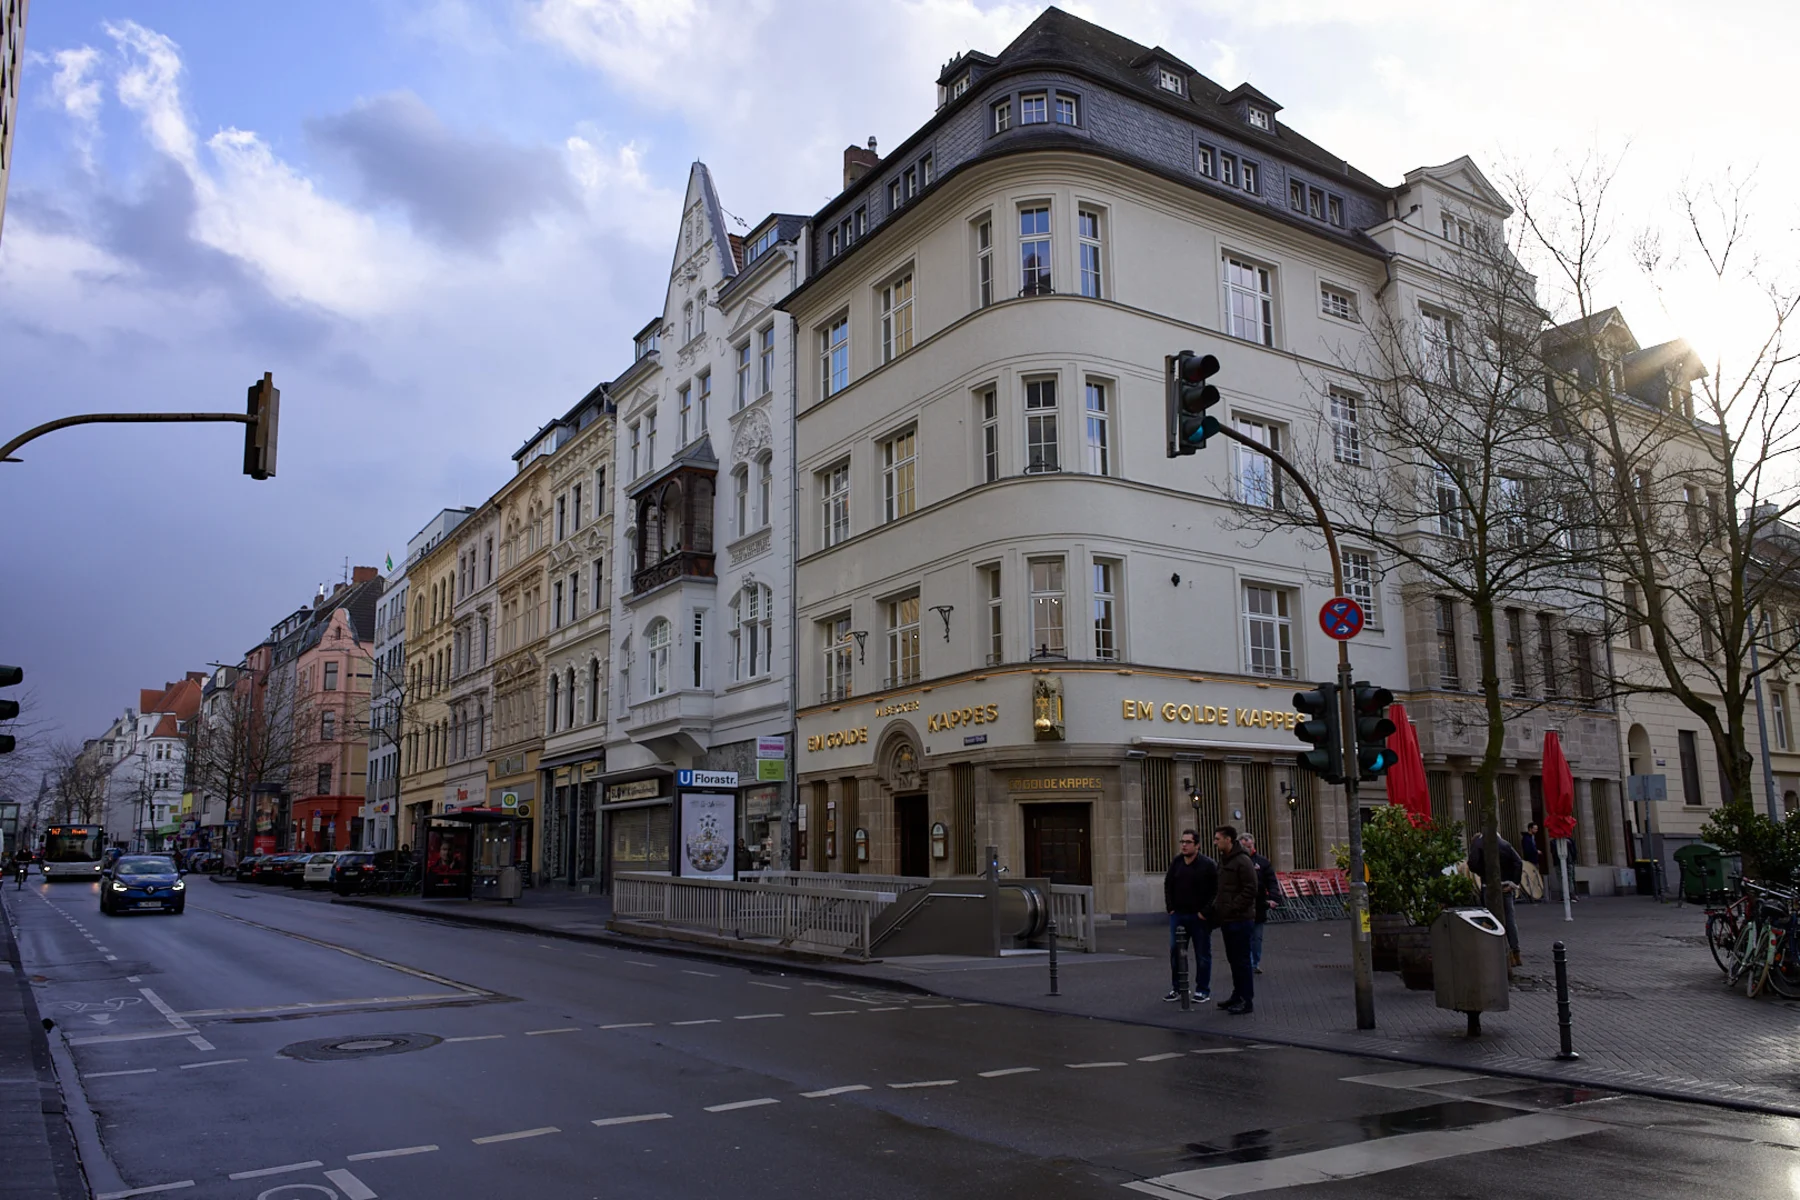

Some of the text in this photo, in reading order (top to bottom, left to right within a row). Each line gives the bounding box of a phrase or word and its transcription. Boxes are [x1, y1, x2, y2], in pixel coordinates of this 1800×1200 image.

[927, 703, 999, 733] KAPPES
[1122, 700, 1154, 721] EM
[1161, 702, 1229, 726] GOLDE
[808, 733, 825, 752] EM
[827, 725, 868, 749] GOLDE
[680, 771, 737, 785] U Florastr.
[1023, 778, 1058, 791] GOLDE
[1060, 777, 1103, 789] KAPPES
